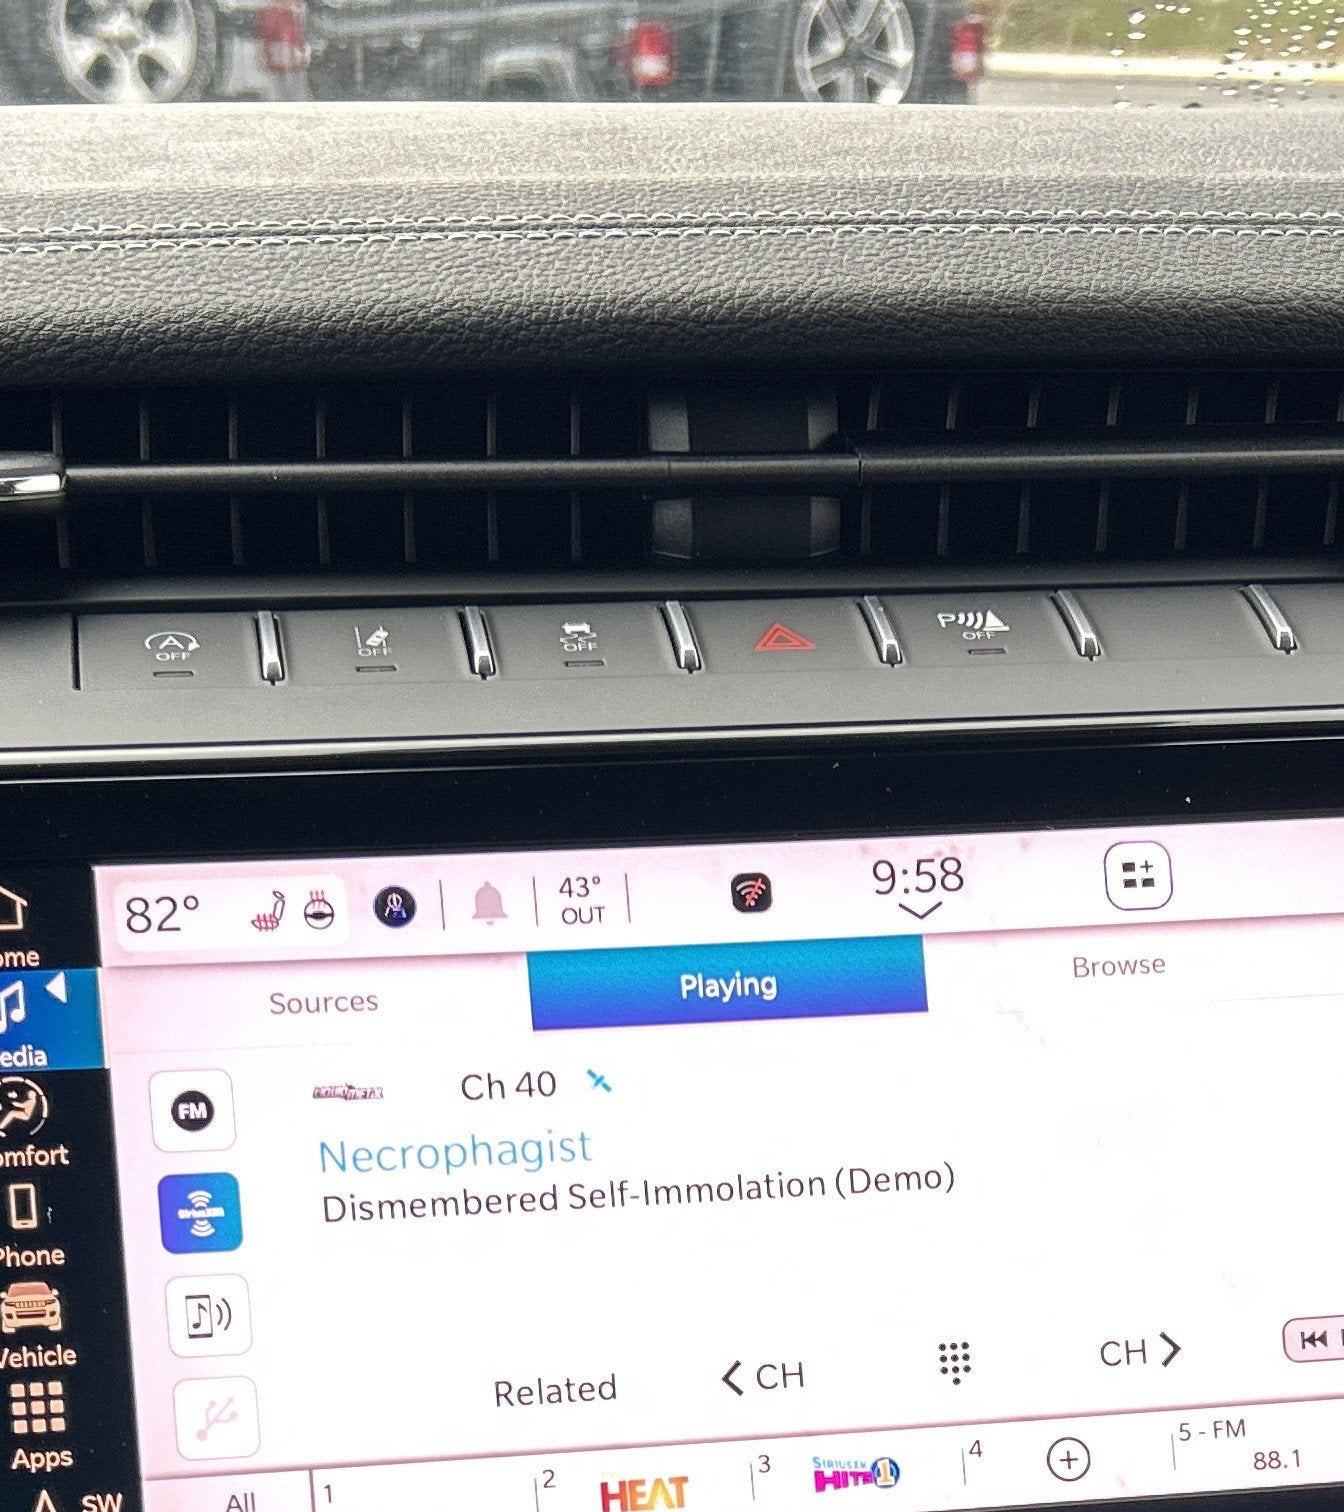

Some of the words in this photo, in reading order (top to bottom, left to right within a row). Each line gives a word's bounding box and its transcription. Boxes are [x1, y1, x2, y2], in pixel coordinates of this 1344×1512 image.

[563, 641, 598, 652] OFF
[962, 631, 995, 640] OFF
[155, 651, 191, 662] OFF
[358, 647, 392, 657] OFF
[559, 875, 601, 898] 43°
[871, 856, 965, 895] 9:58
[126, 895, 200, 934] 82°
[561, 905, 605, 925] OUT
[1072, 955, 1166, 979] Browse
[680, 969, 778, 1003] Playing
[269, 991, 379, 1016] Sources
[461, 1071, 505, 1101] Ch
[514, 1070, 556, 1099] 40
[177, 1101, 208, 1120] FM
[319, 1130, 593, 1175] Necrophagist
[323, 1186, 558, 1224] Dismembered
[568, 1171, 827, 1210] Self-Immolation
[835, 1160, 956, 1198] (Demo)
[1099, 1338, 1148, 1366] CH
[756, 1361, 804, 1390] CH
[495, 1373, 618, 1407] Related
[1178, 1422, 1192, 1441] 5
[1213, 1419, 1246, 1439] FM
[12, 1446, 74, 1471] Apps
[969, 1439, 983, 1459] 4
[1253, 1449, 1302, 1471] 88.1
[758, 1454, 771, 1473] 3
[542, 1470, 556, 1489] 2
[323, 1485, 333, 1503] 1
